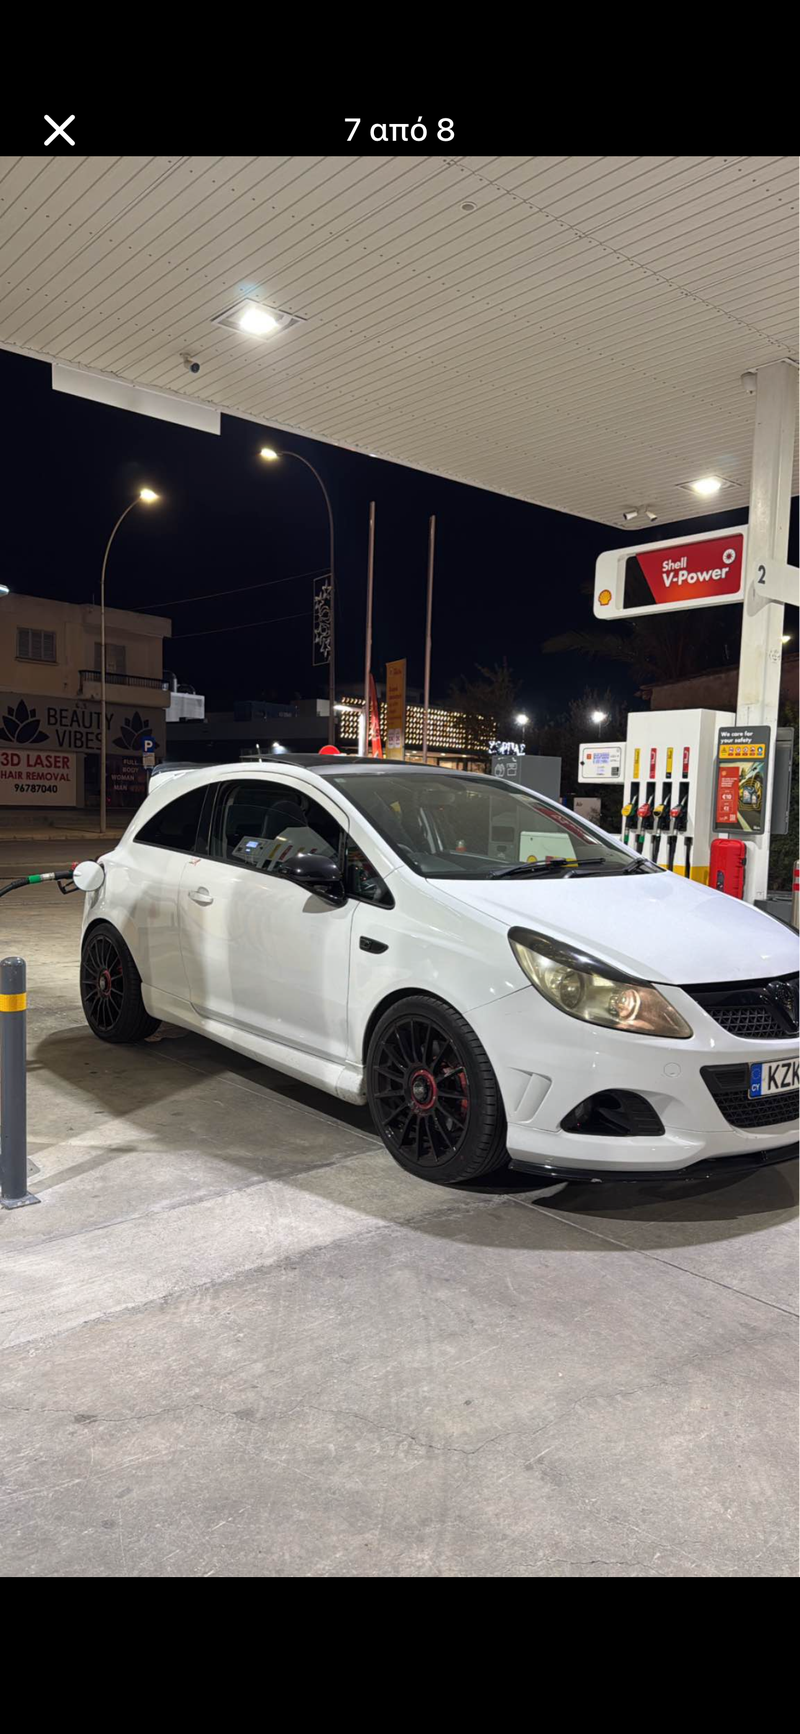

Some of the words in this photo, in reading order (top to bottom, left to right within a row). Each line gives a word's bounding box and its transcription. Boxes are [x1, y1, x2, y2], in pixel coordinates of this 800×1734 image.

[662, 557, 687, 572] Shell
[662, 566, 729, 587] V-Power
[757, 565, 766, 584] 2
[47, 707, 114, 731] BEAUTY
[144, 740, 153, 752] P
[0, 752, 21, 767] 3D
[26, 754, 71, 769] LASER
[0, 771, 23, 780] HAIR
[26, 772, 71, 782] REMOVAL
[14, 784, 58, 793] 96787040
